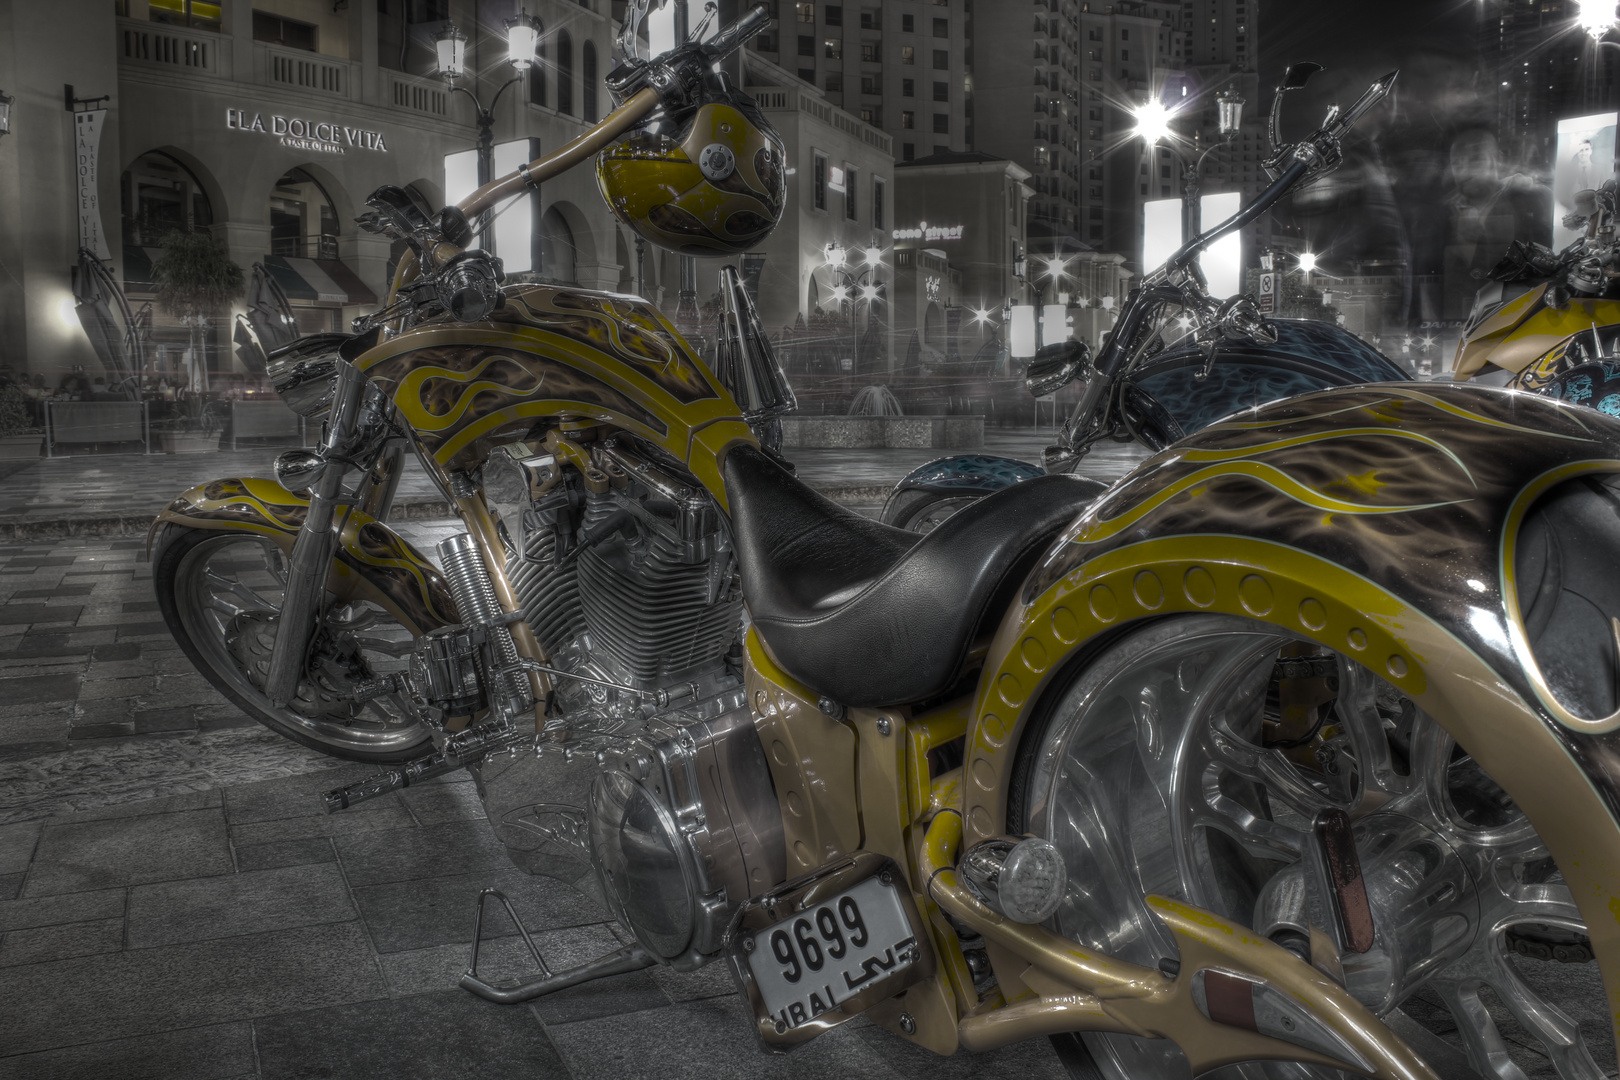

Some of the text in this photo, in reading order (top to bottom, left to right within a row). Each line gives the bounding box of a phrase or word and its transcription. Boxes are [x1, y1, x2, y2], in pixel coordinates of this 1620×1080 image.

[79, 126, 86, 148] LA
[238, 110, 388, 152] LA DOLCE VITA
[287, 138, 312, 150] TASTE
[312, 141, 324, 152] OF
[325, 144, 348, 155] ITALY
[79, 155, 87, 209] DOLCE
[769, 896, 869, 984] 9699
